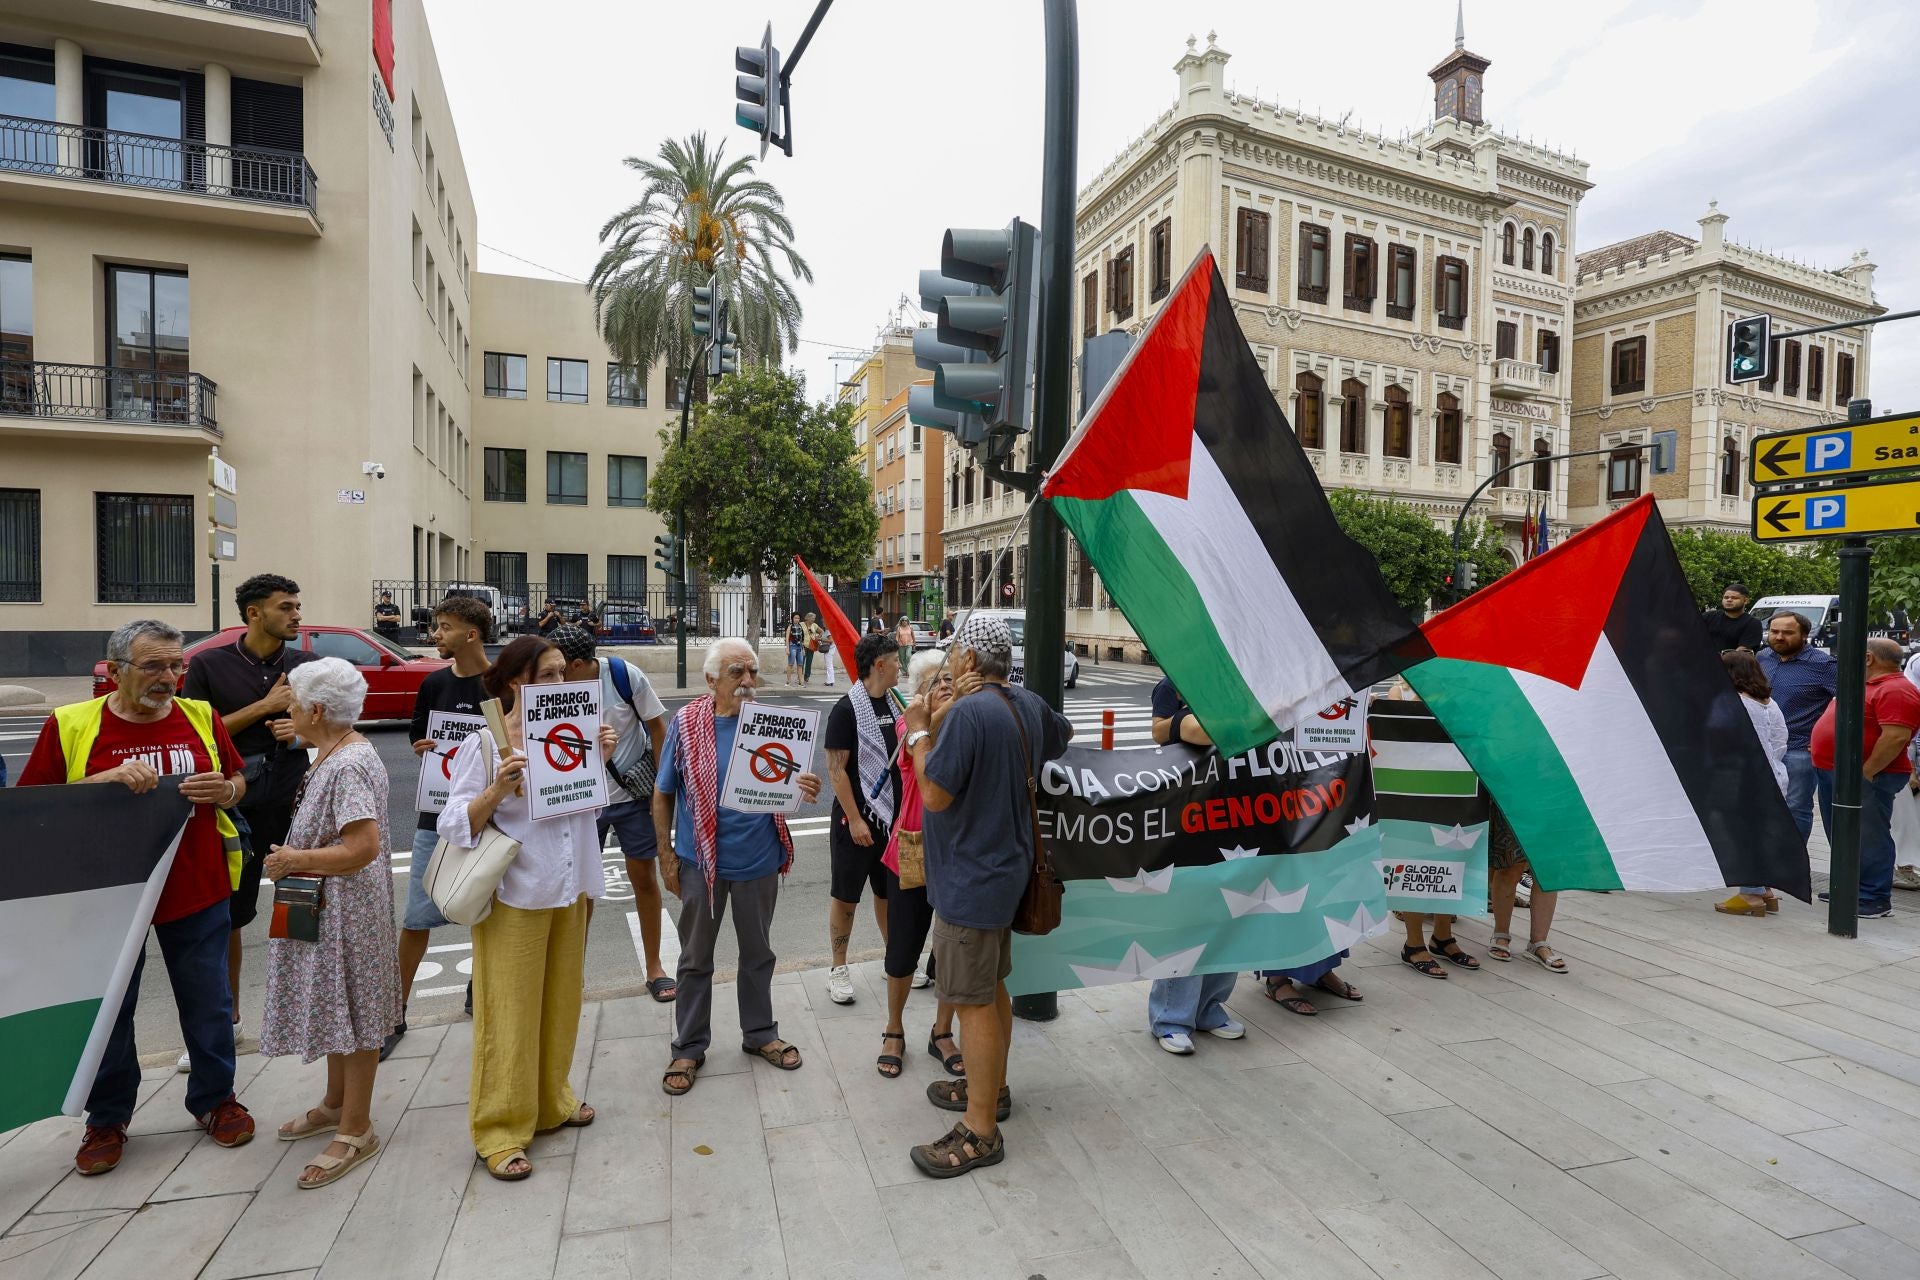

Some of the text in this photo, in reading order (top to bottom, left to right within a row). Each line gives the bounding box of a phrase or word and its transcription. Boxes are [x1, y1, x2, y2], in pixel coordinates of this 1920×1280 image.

[1490, 399, 1547, 419] ALECENCIA
[1814, 436, 1845, 469] P
[1874, 446, 1919, 461] Saa
[1813, 499, 1840, 527] P
[536, 691, 590, 708] ¡EMBARGO
[528, 703, 598, 722] DE ARMAS YA!
[753, 713, 806, 730] ¡EMBARGO
[432, 729, 446, 740] DE
[742, 723, 812, 742] DE ARMAS YA!
[1322, 736, 1351, 744] PALESTINA
[112, 745, 162, 756] PALESTINA
[1040, 759, 1111, 799] CIA
[1113, 765, 1182, 796] CON
[1191, 755, 1220, 786] LA
[540, 778, 597, 796] REGIÓN de MURCIA
[547, 789, 593, 806] CON PALESTINA
[738, 797, 785, 806] CON PALESTINA
[768, 792, 793, 800] MURCIA
[1037, 778, 1347, 845] EMOS EL GENOCIDIO
[1403, 873, 1444, 884] SUMUD
[1405, 865, 1452, 876] GLOBAL
[1401, 882, 1457, 893] FLOTILLA
